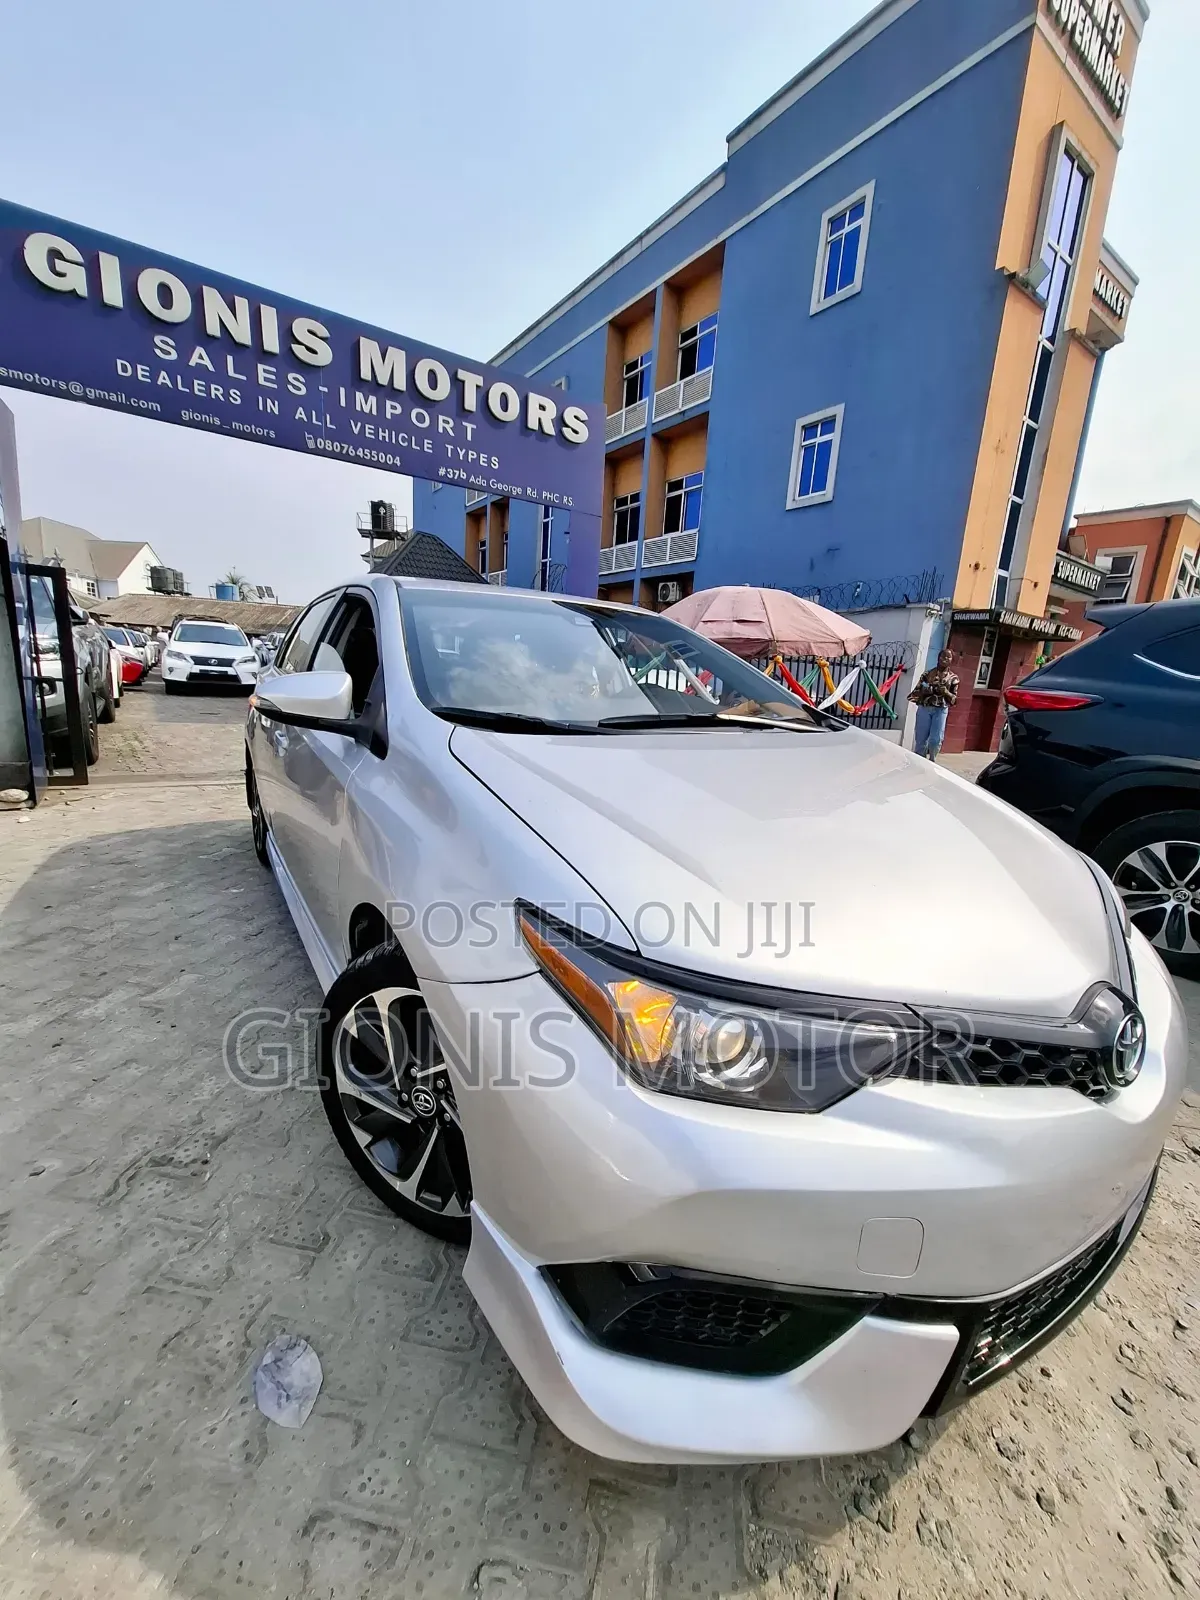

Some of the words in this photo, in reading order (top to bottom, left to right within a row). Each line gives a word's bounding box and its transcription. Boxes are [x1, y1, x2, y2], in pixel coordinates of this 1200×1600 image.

[1085, 0, 1126, 57] MER
[23, 232, 332, 367] GIONIS
[359, 336, 590, 444] MOTORS
[0, 366, 162, 412] smotors@gmail.com
[116, 358, 242, 405] DEALERS
[258, 396, 279, 415] IN
[295, 407, 337, 429] ALL
[350, 419, 433, 453] VEHICLE
[445, 444, 500, 469] TYPES
[317, 438, 401, 467] 08076455004
[438, 467, 467, 480] #37b
[469, 475, 487, 487] Ada
[490, 479, 523, 495] George
[542, 491, 560, 503] PHC
[1057, 560, 1101, 591] SUPERMARKET
